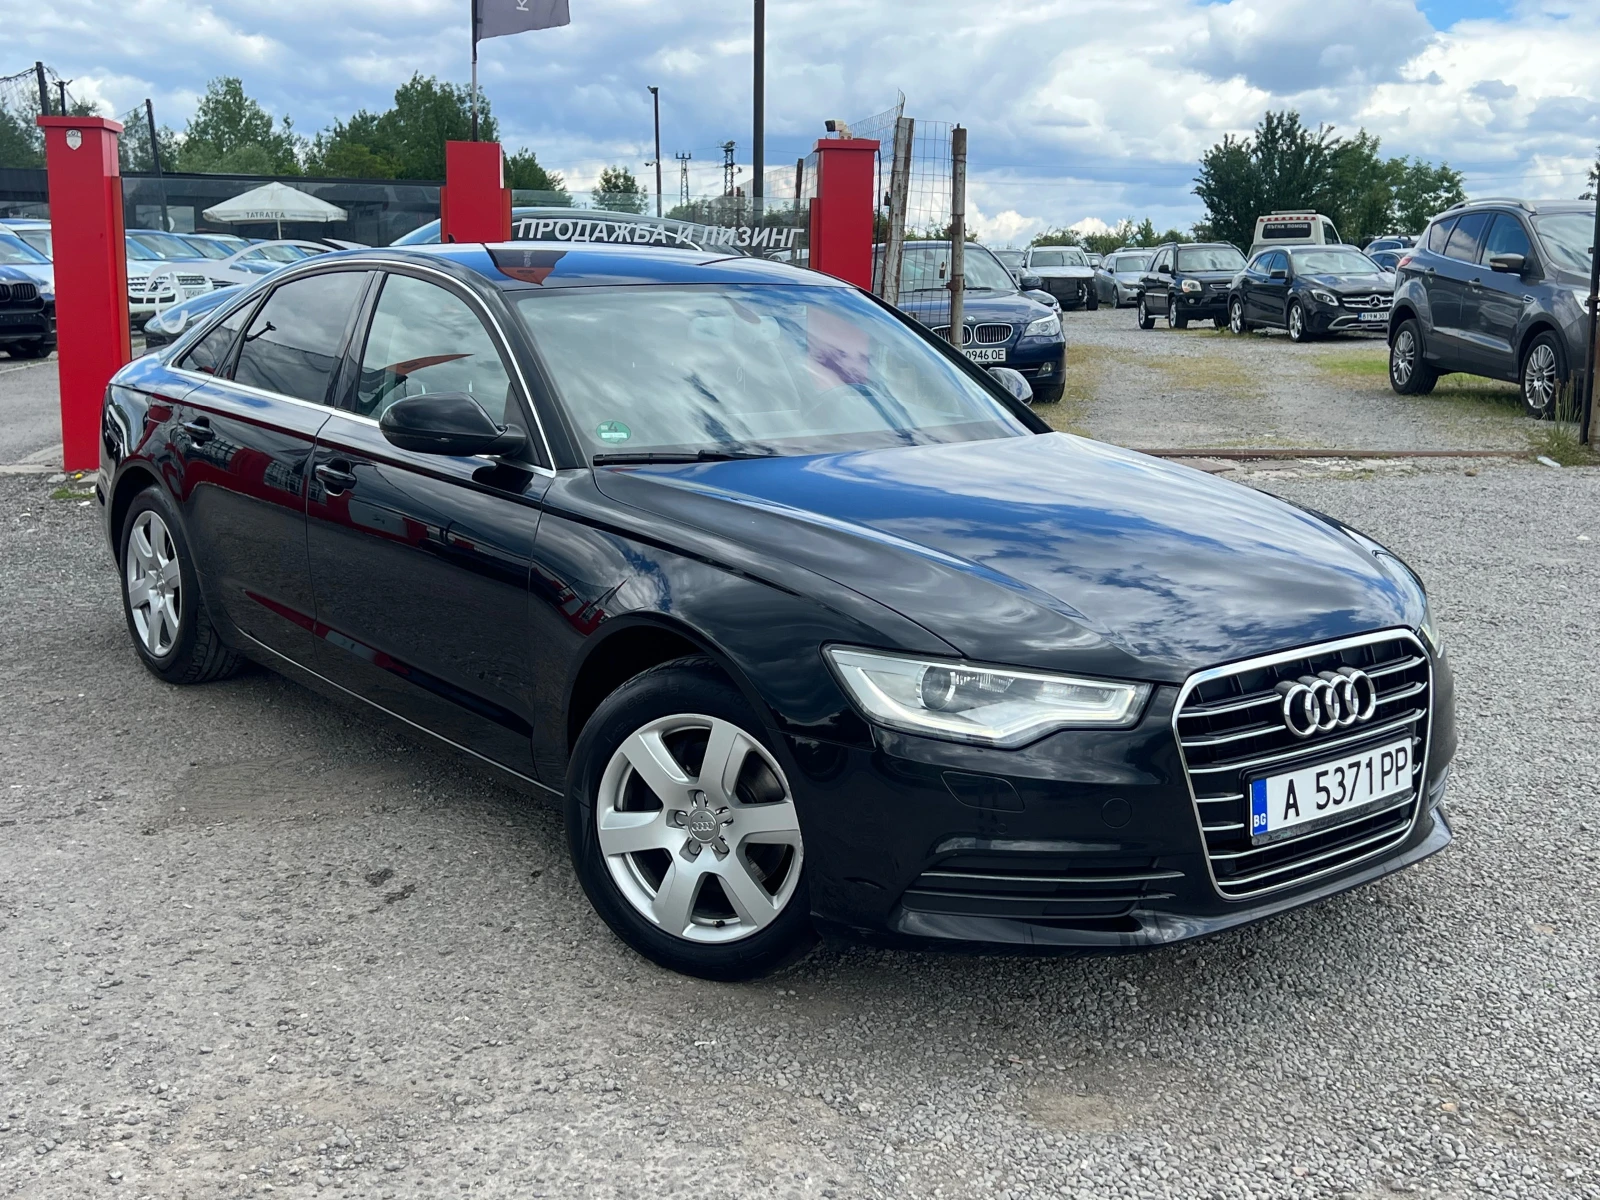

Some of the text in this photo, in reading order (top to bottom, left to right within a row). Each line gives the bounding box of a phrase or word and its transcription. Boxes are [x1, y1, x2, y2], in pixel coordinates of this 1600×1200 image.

[246, 211, 286, 219] TATRATEA
[518, 218, 805, 247] ПРОДАЖБА И ЛИЗИНГ
[965, 350, 989, 360] 0946
[1283, 778, 1300, 820] A
[1316, 756, 1373, 810] 5371
[1380, 746, 1408, 791] PP
[1253, 813, 1267, 828] BG
